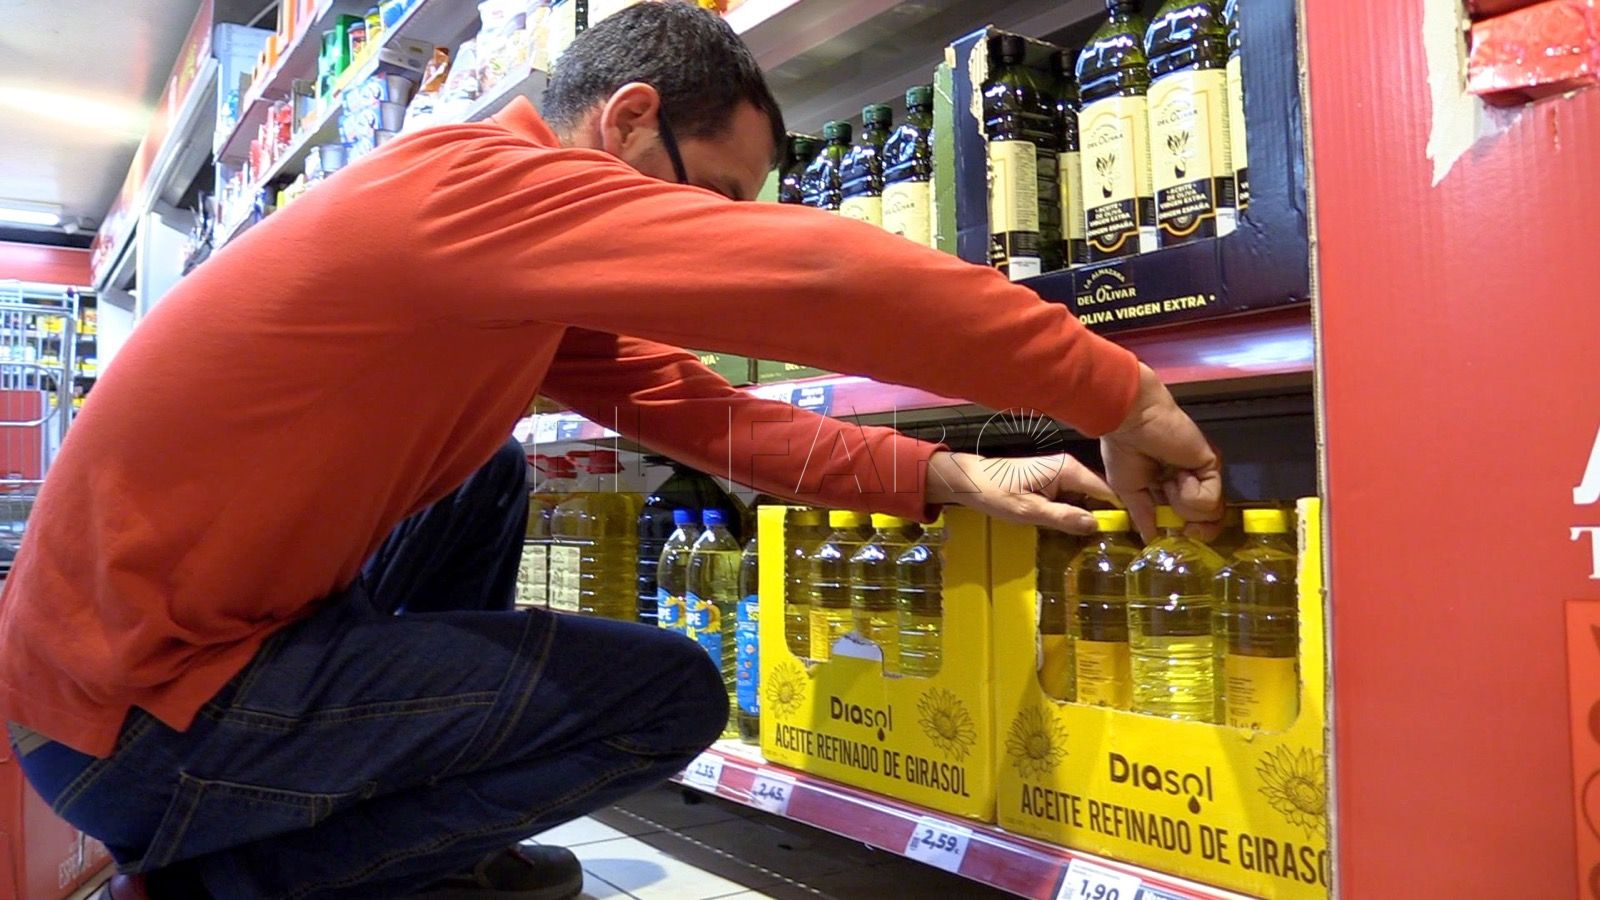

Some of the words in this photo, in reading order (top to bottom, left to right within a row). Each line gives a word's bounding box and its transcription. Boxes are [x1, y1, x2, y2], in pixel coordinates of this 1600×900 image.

[1083, 278, 1093, 290] LA
[1091, 267, 1126, 283] ALMAZARA
[1077, 294, 1096, 307] DEL
[1096, 286, 1137, 304] OLIVAR
[1080, 310, 1114, 326] OLIVA
[1115, 302, 1161, 320] VIRGEN
[1163, 294, 1207, 312] EXTRA
[775, 723, 813, 756] ACEITE
[816, 733, 879, 774] REFINADO
[883, 748, 901, 780] DE
[905, 755, 970, 797] GIRASOL
[1020, 783, 1084, 828] ACEITE
[1089, 799, 1192, 855] REFINADO
[1199, 824, 1231, 865] DE
